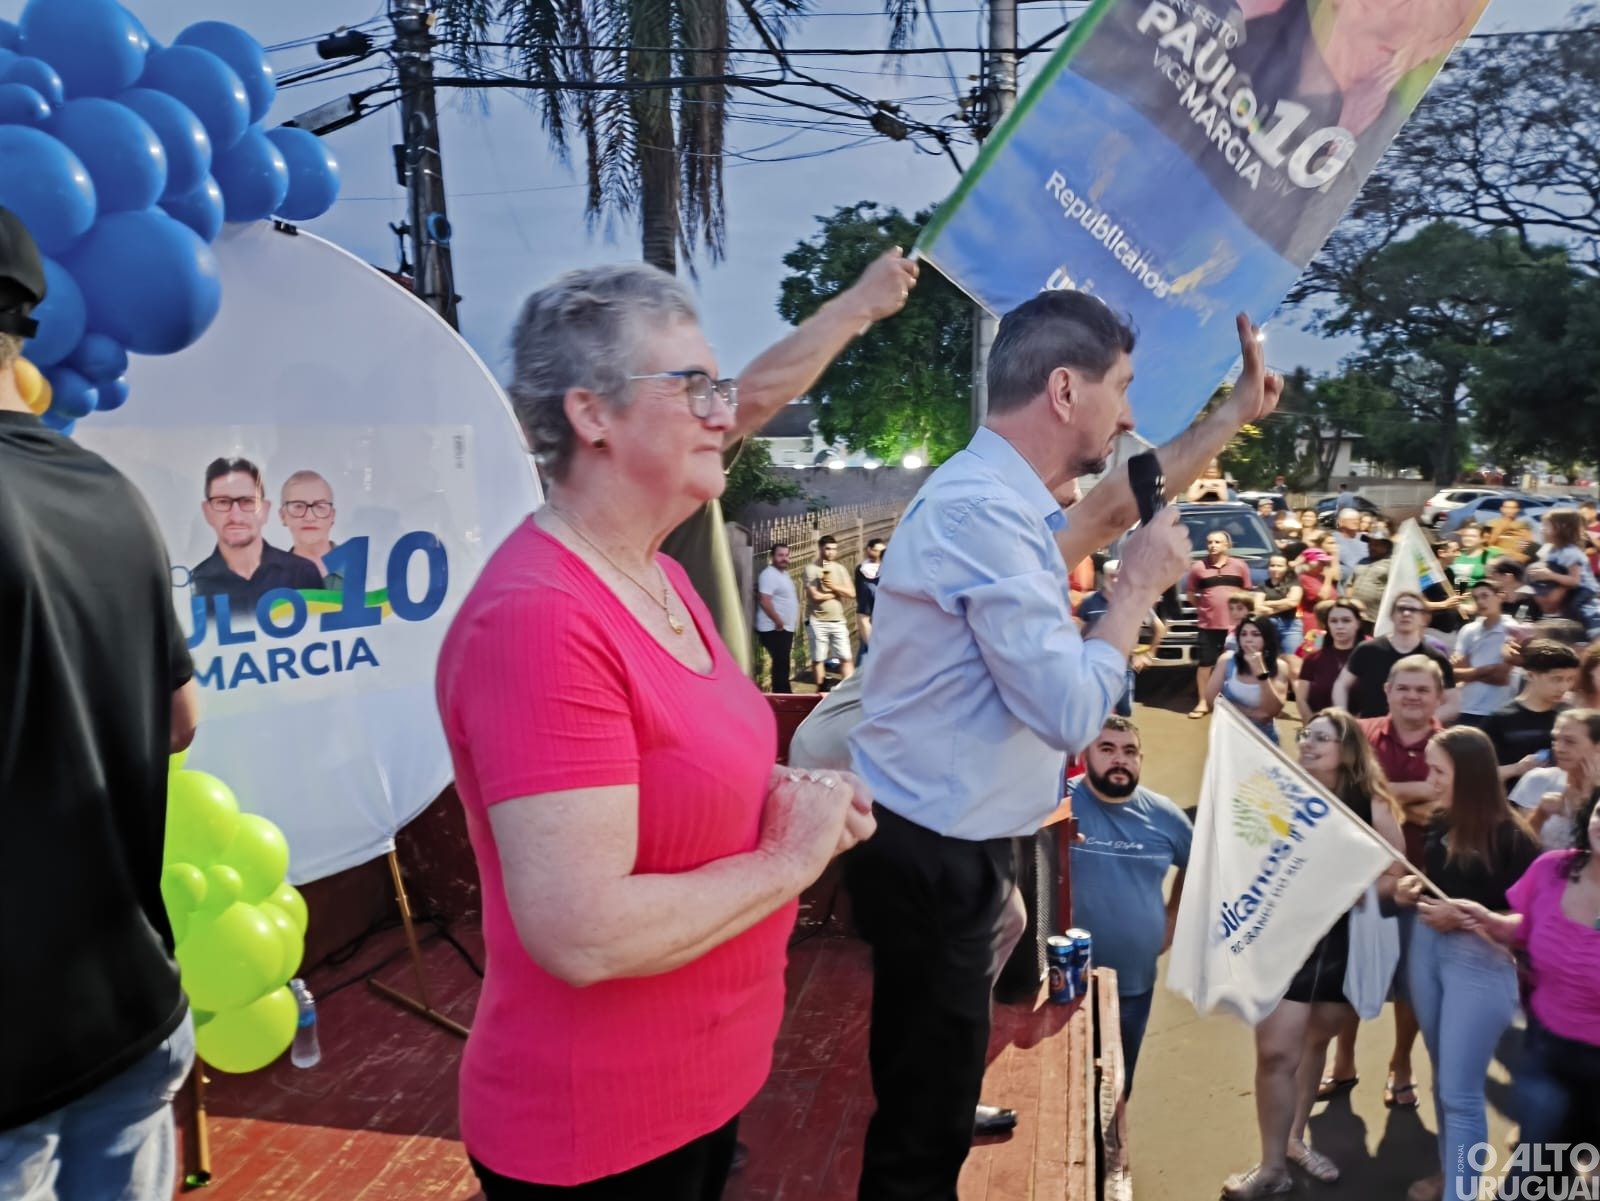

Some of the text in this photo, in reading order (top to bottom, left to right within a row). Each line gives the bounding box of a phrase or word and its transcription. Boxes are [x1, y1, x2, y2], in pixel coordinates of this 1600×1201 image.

[1136, 0, 1357, 189] PAULO 10
[1179, 80, 1263, 191] MARCIA
[1045, 170, 1171, 298] Republicanos
[186, 530, 449, 650] ULO 10
[192, 636, 380, 691] MARCIA
[1293, 796, 1330, 828] 10
